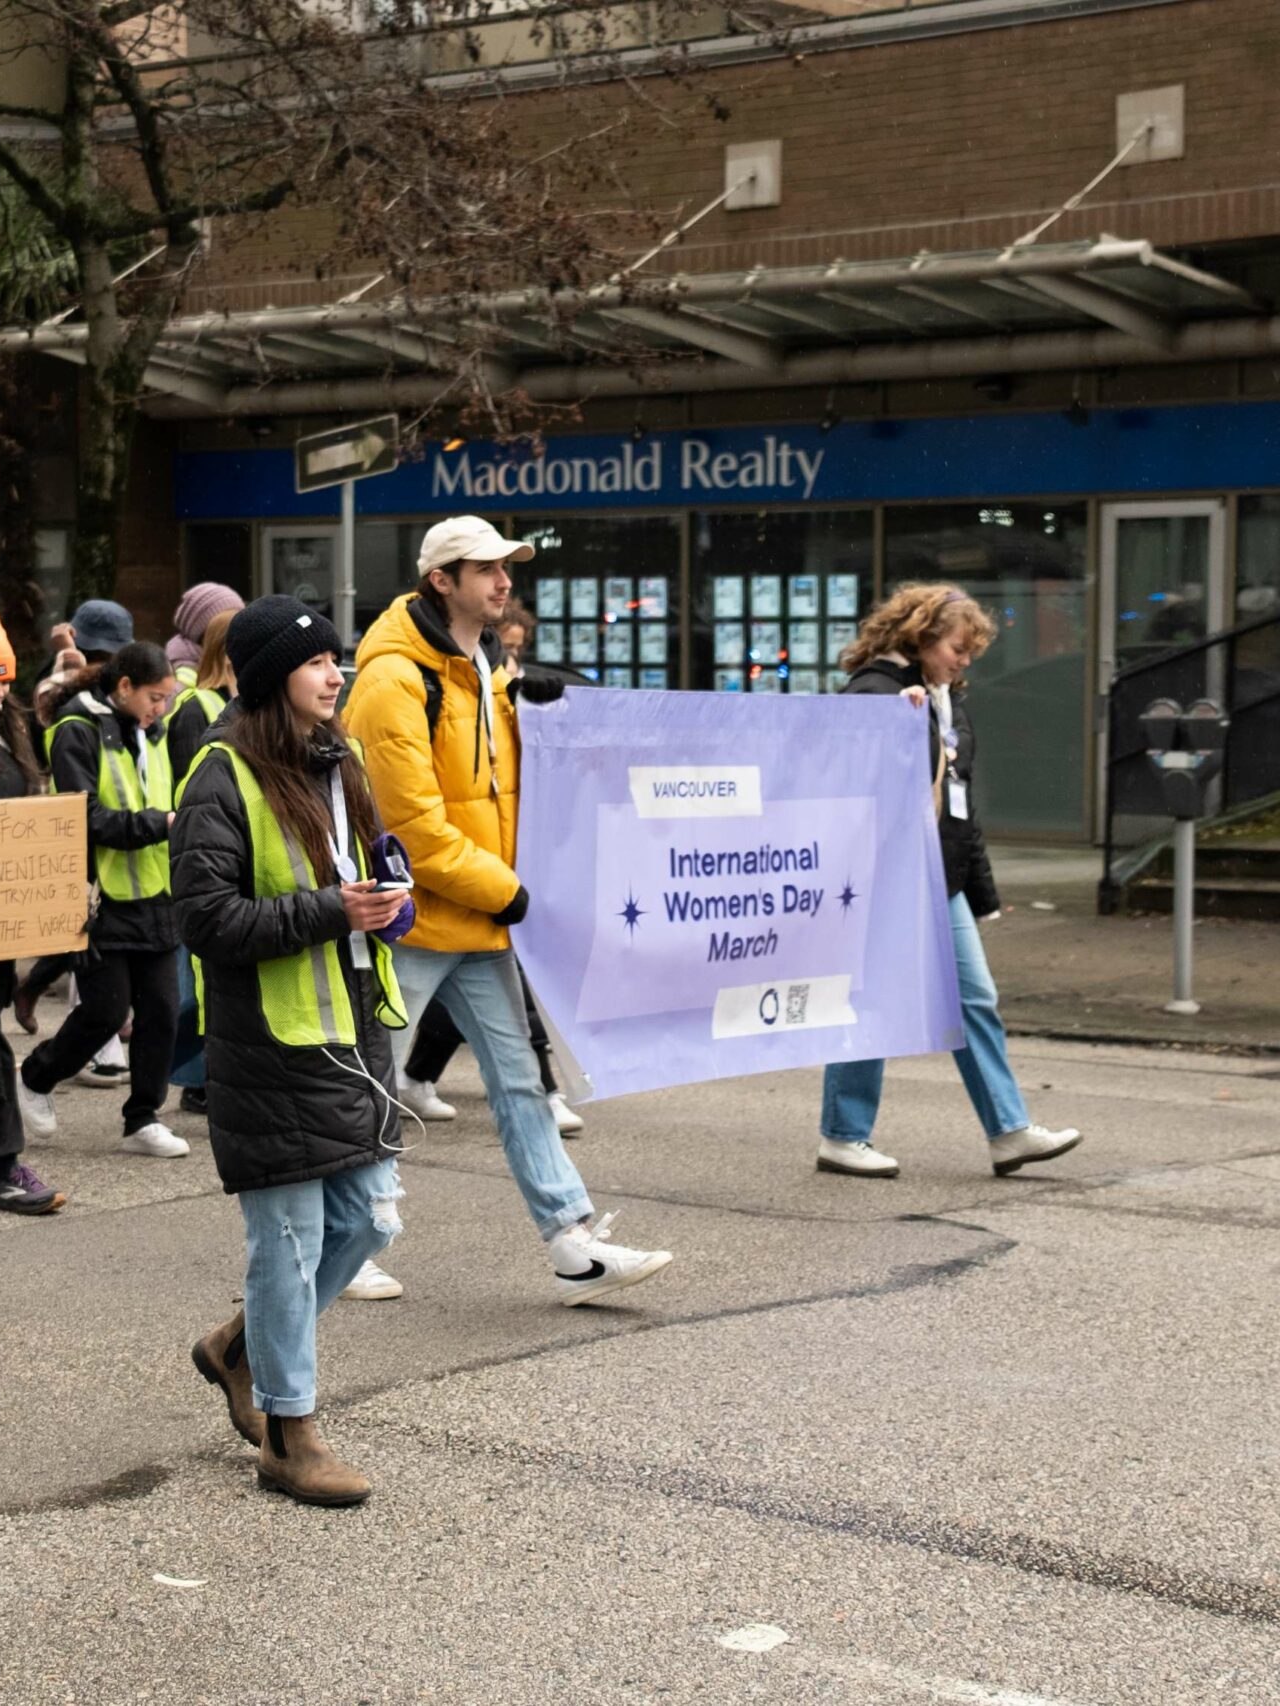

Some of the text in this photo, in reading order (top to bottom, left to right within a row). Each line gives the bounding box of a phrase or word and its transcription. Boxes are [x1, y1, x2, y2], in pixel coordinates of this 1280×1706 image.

[432, 435, 825, 499] Macdonald Realty
[652, 780, 737, 798] VANCOUVER
[0, 817, 38, 843] FOR
[49, 817, 76, 837] THE
[669, 841, 819, 878] International
[0, 884, 57, 905] TRYING
[66, 883, 81, 899] TO
[663, 884, 825, 922] Women's Day
[38, 913, 85, 937] WORLD
[707, 928, 778, 963] March
